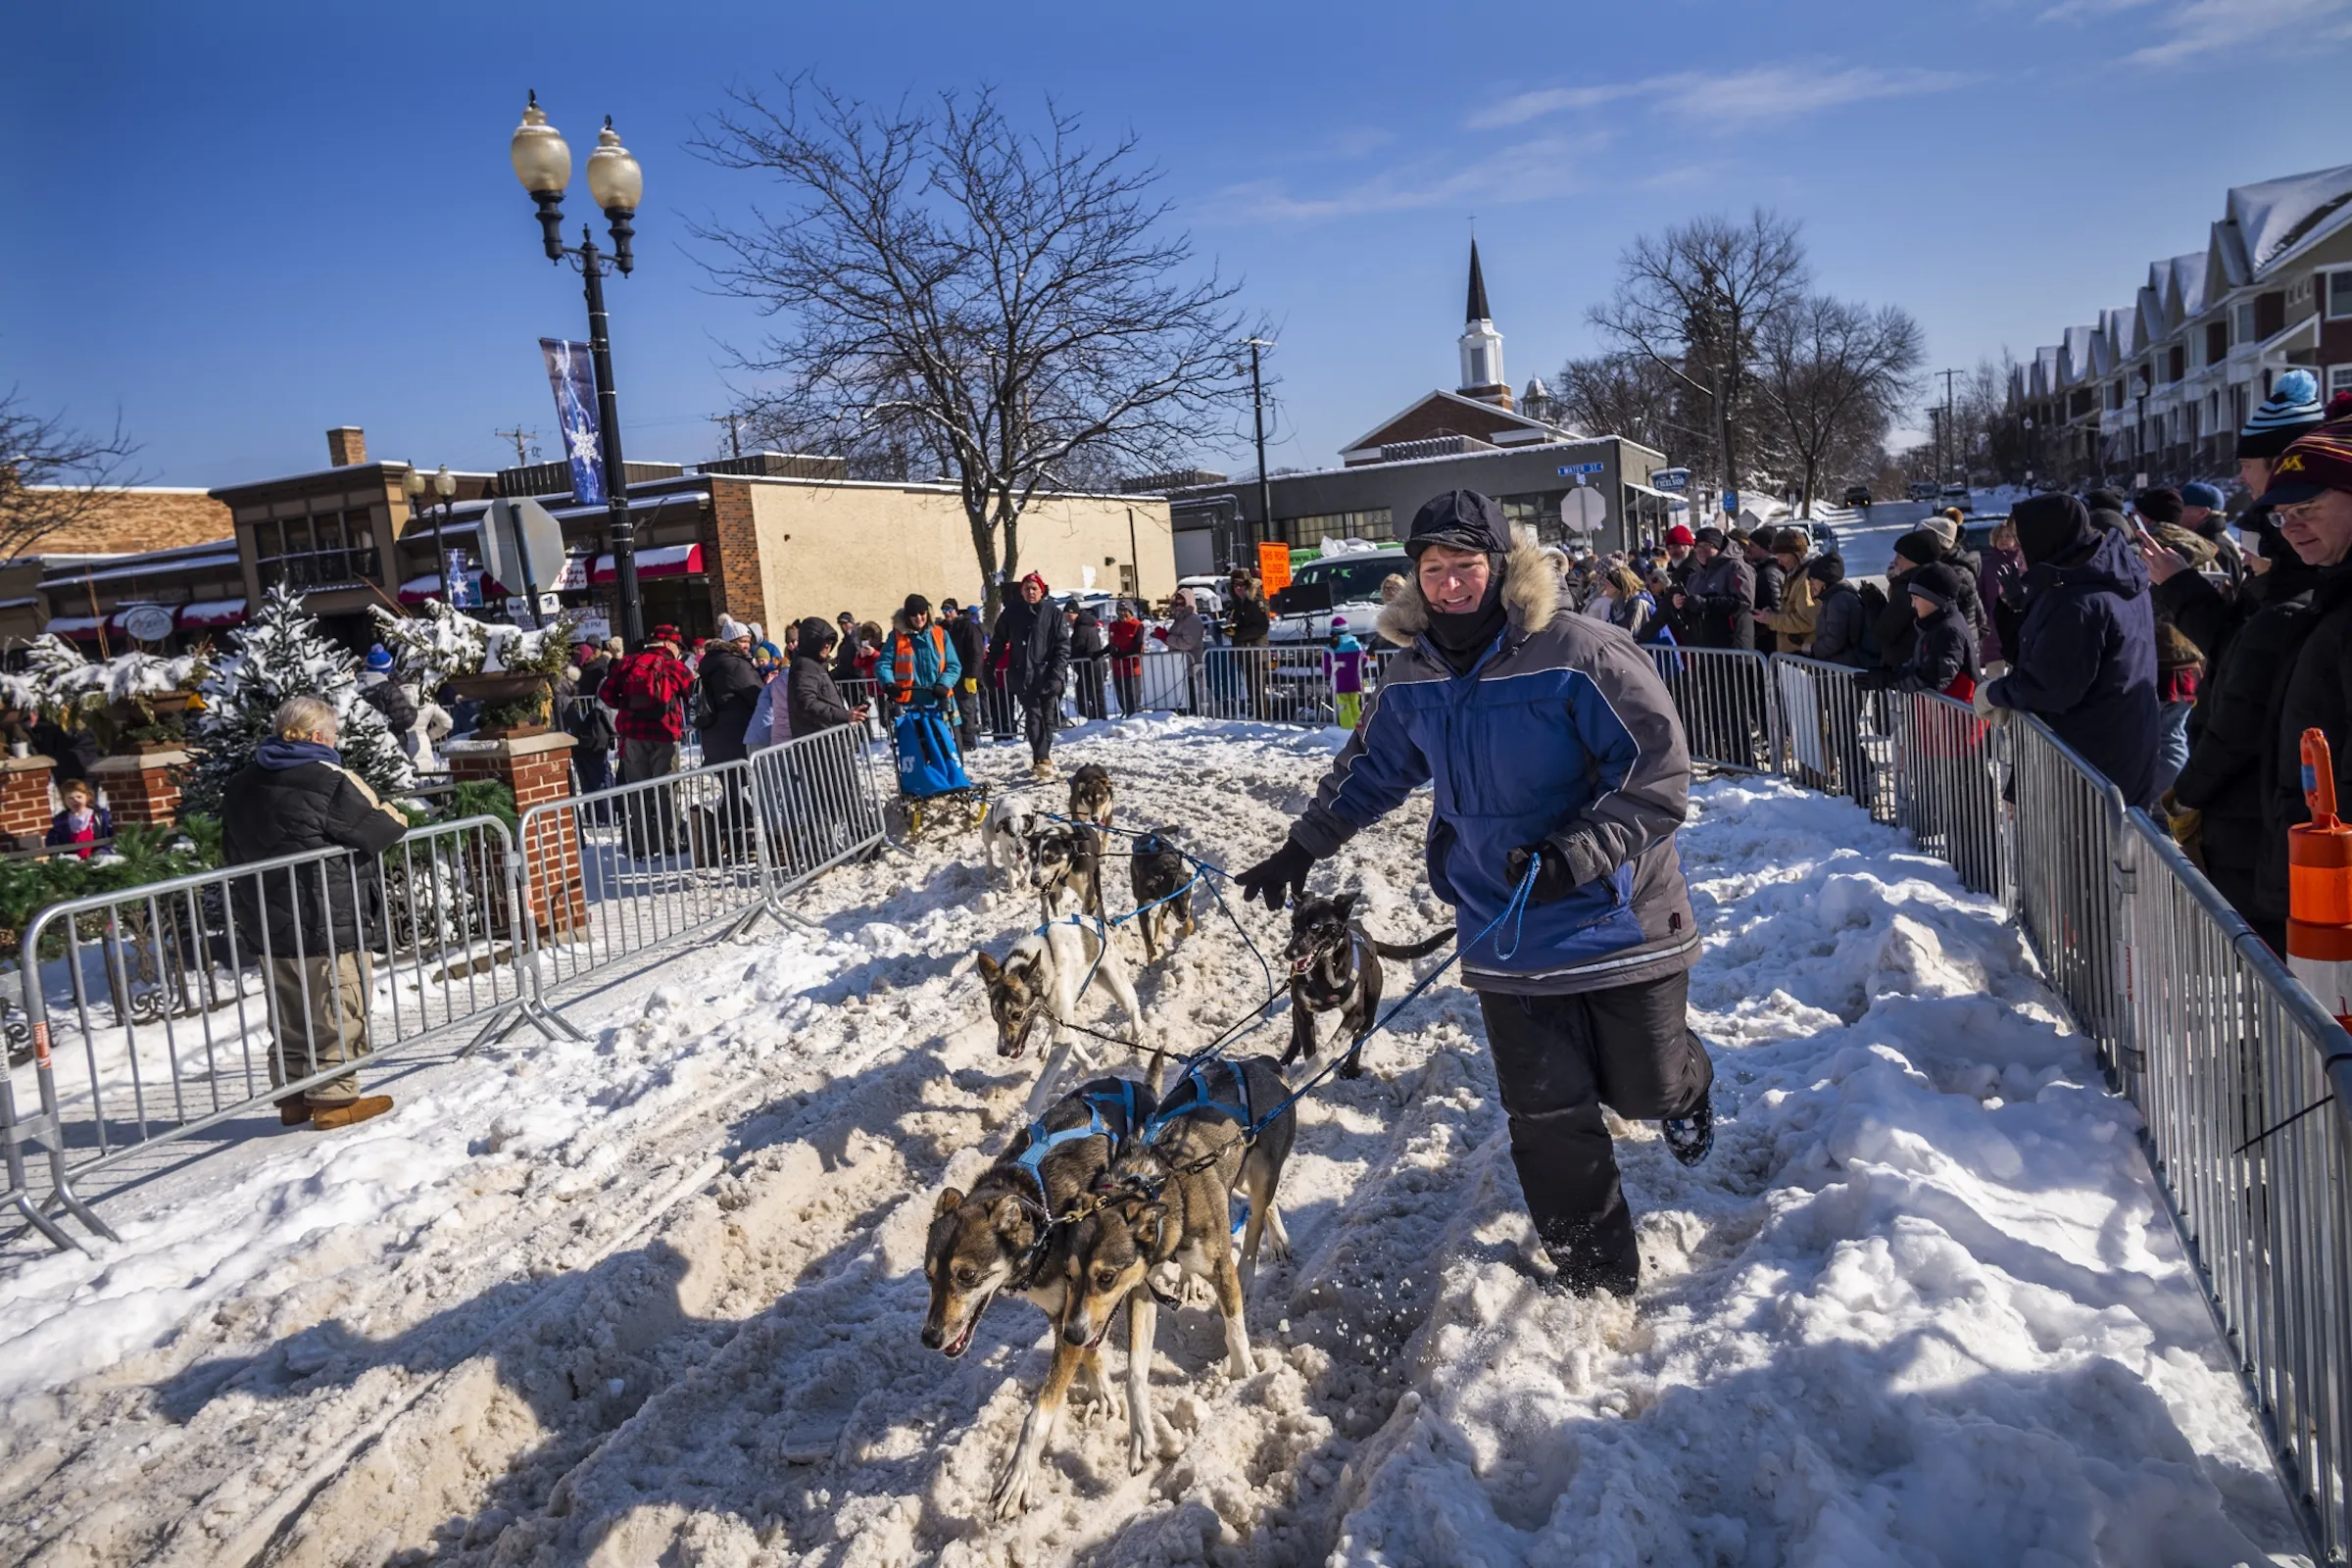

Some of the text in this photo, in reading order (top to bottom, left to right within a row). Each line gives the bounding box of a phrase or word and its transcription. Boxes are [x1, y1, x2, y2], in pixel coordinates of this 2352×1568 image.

[1564, 464, 1597, 475] WATER ST
[1655, 477, 1685, 489] EXCELSIOR
[1266, 564, 1285, 573] CLOSED
